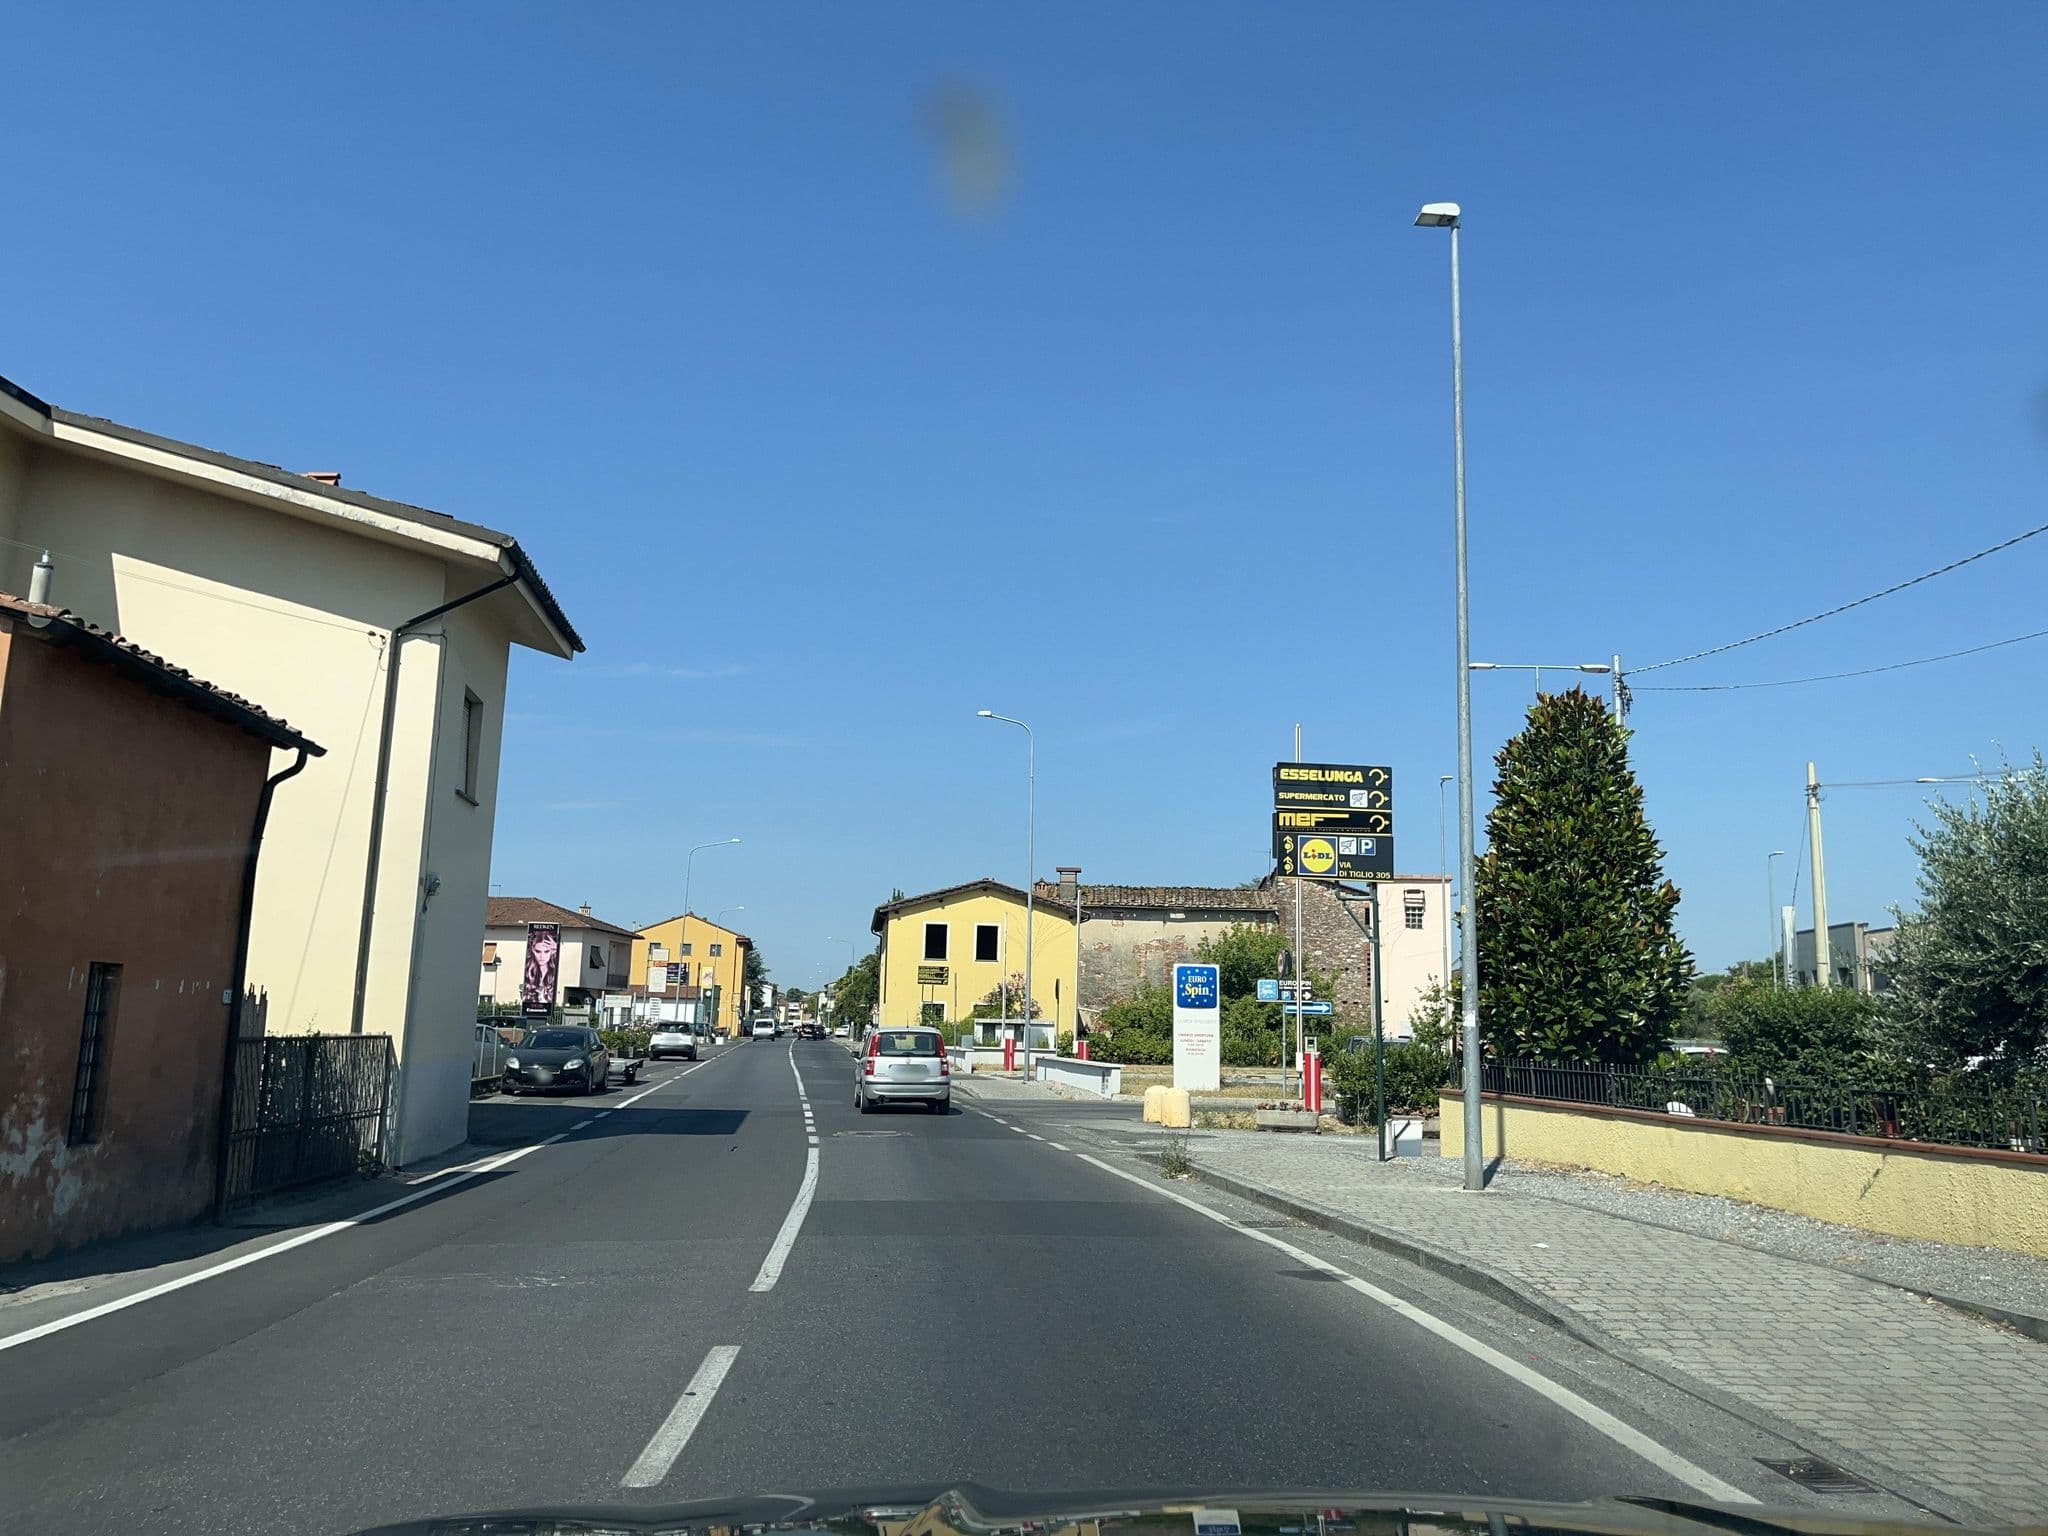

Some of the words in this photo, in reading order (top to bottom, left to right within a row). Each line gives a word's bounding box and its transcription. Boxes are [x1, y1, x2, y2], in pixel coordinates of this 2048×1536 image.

[1280, 768, 1363, 783] ESSELUNGA
[1278, 792, 1345, 802] SUPERMERCATO
[1339, 861, 1351, 869] VIA
[1349, 871, 1374, 879] TIGLIO
[1376, 872, 1391, 880] 305
[1187, 975, 1207, 983] EURO
[1184, 983, 1210, 998] Spin
